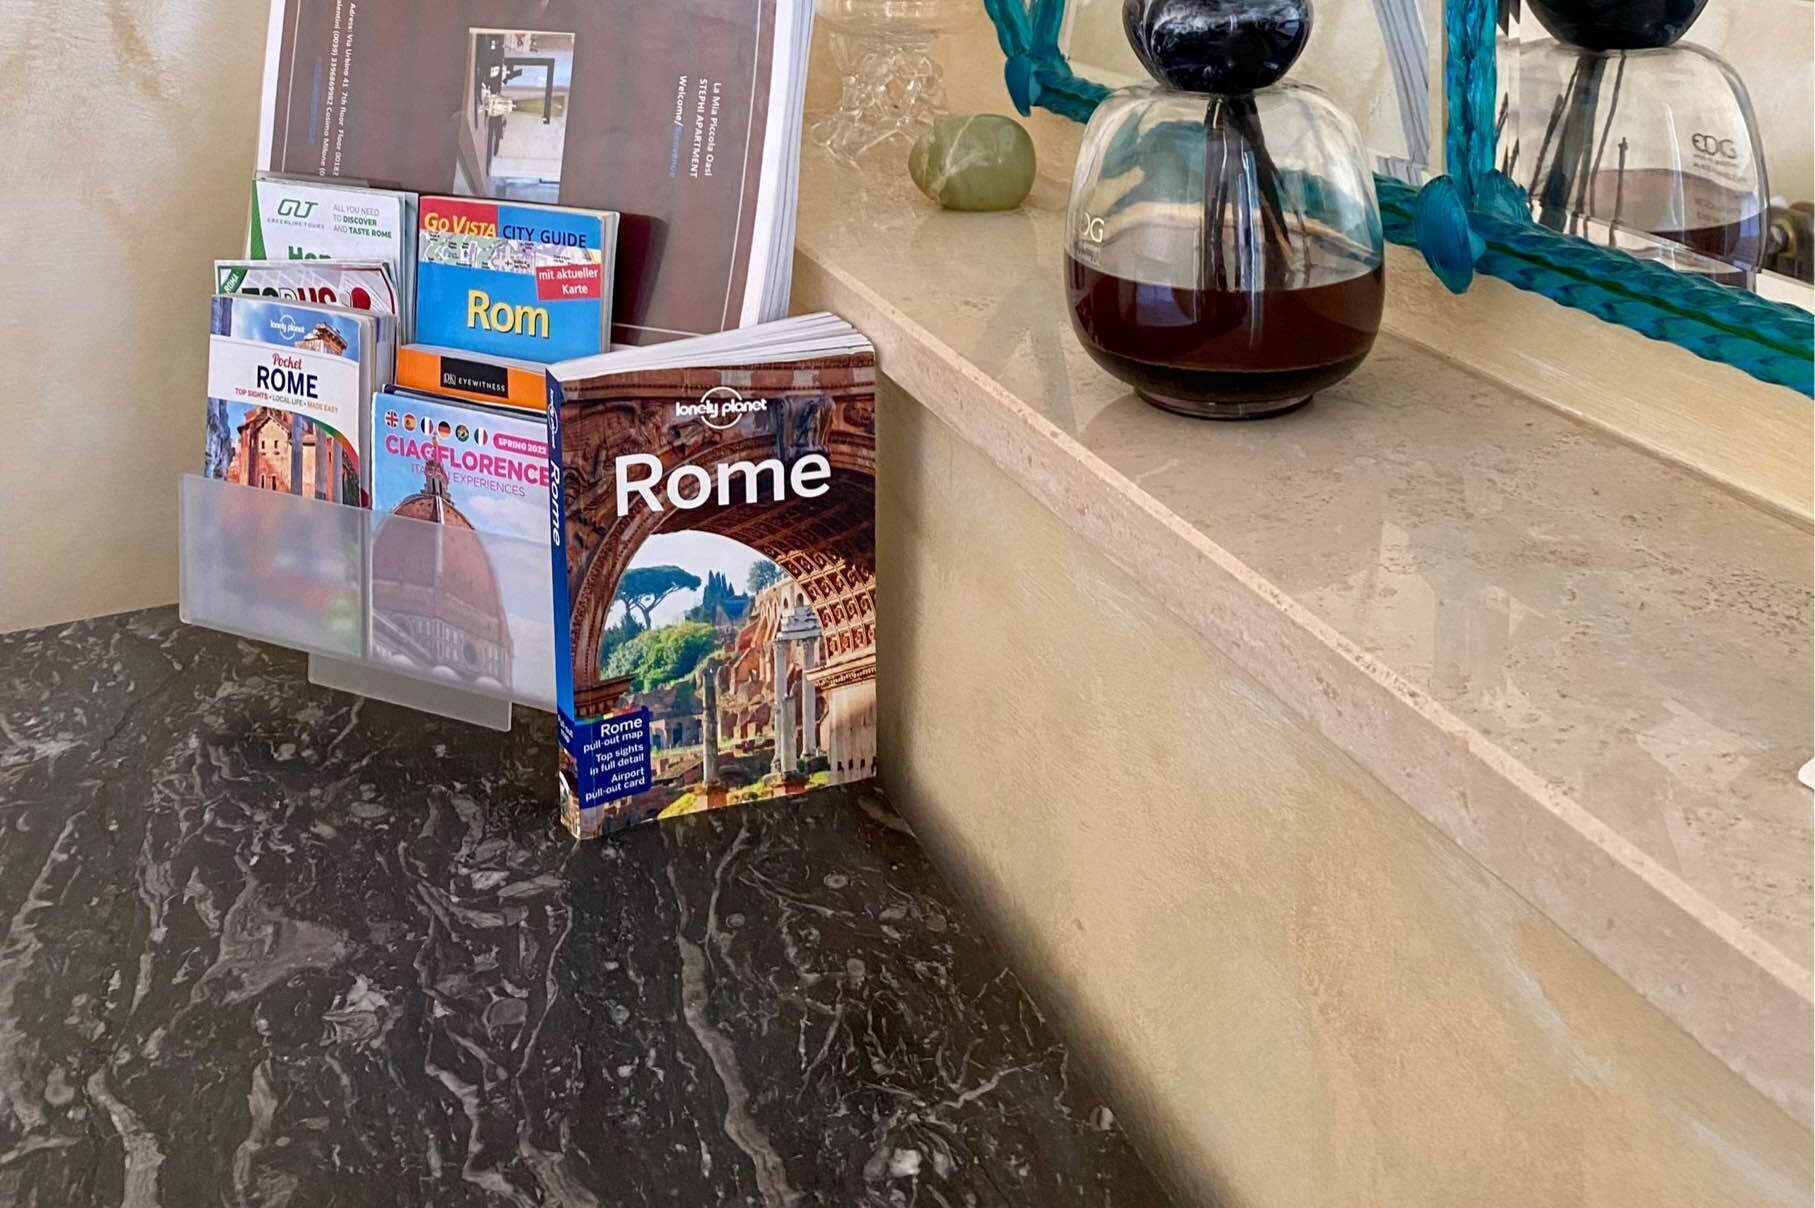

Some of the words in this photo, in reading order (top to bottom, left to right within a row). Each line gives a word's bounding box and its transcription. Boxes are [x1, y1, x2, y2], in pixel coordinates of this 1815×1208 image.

[343, 48, 352, 76] Urbino
[696, 78, 708, 113] STEPHI
[713, 82, 722, 94] La
[711, 95, 721, 115] Mia
[707, 117, 718, 152] Piccola
[689, 114, 704, 179] APARTMENT
[704, 154, 715, 176] Oasi
[333, 203, 345, 213] ALL
[346, 205, 360, 214] YOU
[361, 207, 380, 216] NEED
[333, 214, 342, 222] TO
[343, 215, 377, 226] DISCOVER
[333, 224, 348, 233] AND
[349, 226, 371, 237] TASTE
[371, 229, 392, 239] ROME
[502, 224, 535, 241] CITY
[540, 229, 587, 249] GUIDE
[538, 268, 554, 280] mit
[556, 267, 599, 280] aktueller
[562, 283, 589, 295] Karte
[466, 289, 550, 339] Rom
[270, 319, 287, 333] lonely
[272, 352, 303, 370] Pocket
[256, 365, 319, 399] ROME
[458, 377, 505, 392] EYEWITNESS
[234, 387, 248, 396] TOP
[249, 389, 269, 400] SIGHTS
[272, 394, 291, 404] LOCAL
[292, 396, 303, 406] LIFE
[307, 401, 323, 411] MADE
[323, 404, 339, 414] EASY
[675, 399, 719, 418] lonely
[721, 398, 767, 417] planet
[498, 437, 527, 450] SPRING
[453, 472, 526, 497] EXPERIENCES
[615, 453, 832, 517] Rome
[550, 460, 561, 546] Rome
[600, 717, 643, 738] Rome
[583, 734, 620, 754] pull-out
[622, 729, 644, 742] map
[595, 750, 613, 764] Top
[615, 743, 644, 757] sights
[590, 765, 599, 776] in
[601, 760, 616, 774] full
[617, 753, 645, 767] detail
[611, 766, 645, 784] Airport
[585, 782, 621, 802] pull-out
[623, 776, 646, 789] card
